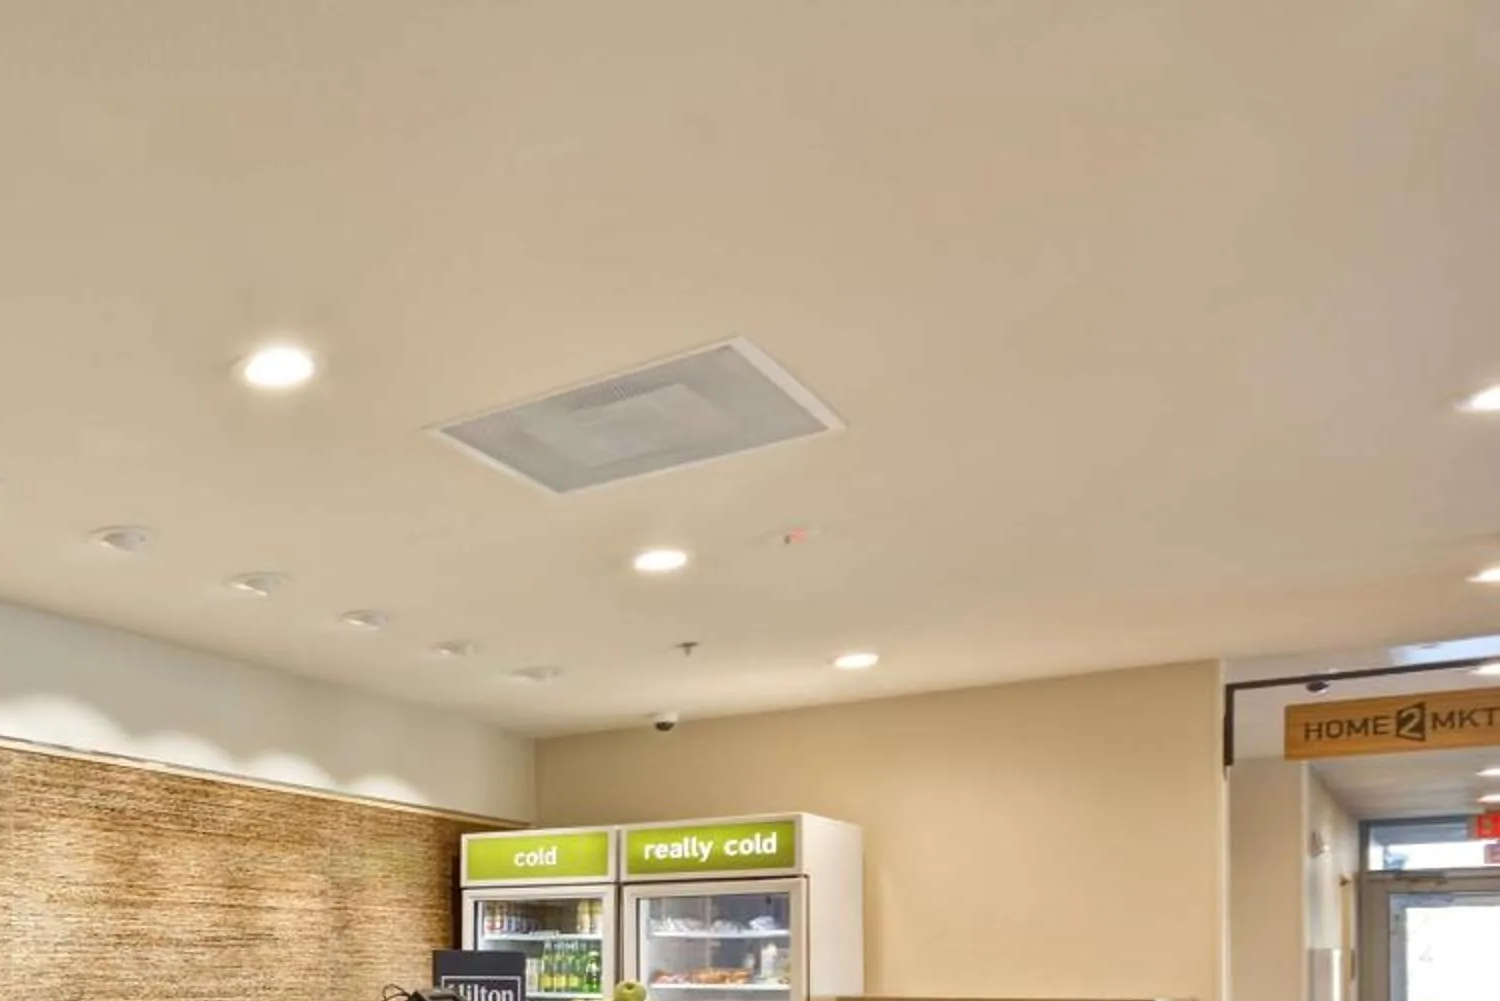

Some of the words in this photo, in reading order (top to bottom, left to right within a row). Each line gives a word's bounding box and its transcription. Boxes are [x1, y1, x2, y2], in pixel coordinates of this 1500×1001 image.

[1432, 707, 1500, 732] MKT
[514, 846, 558, 867] cold
[643, 837, 713, 863] really
[724, 832, 777, 857] cold
